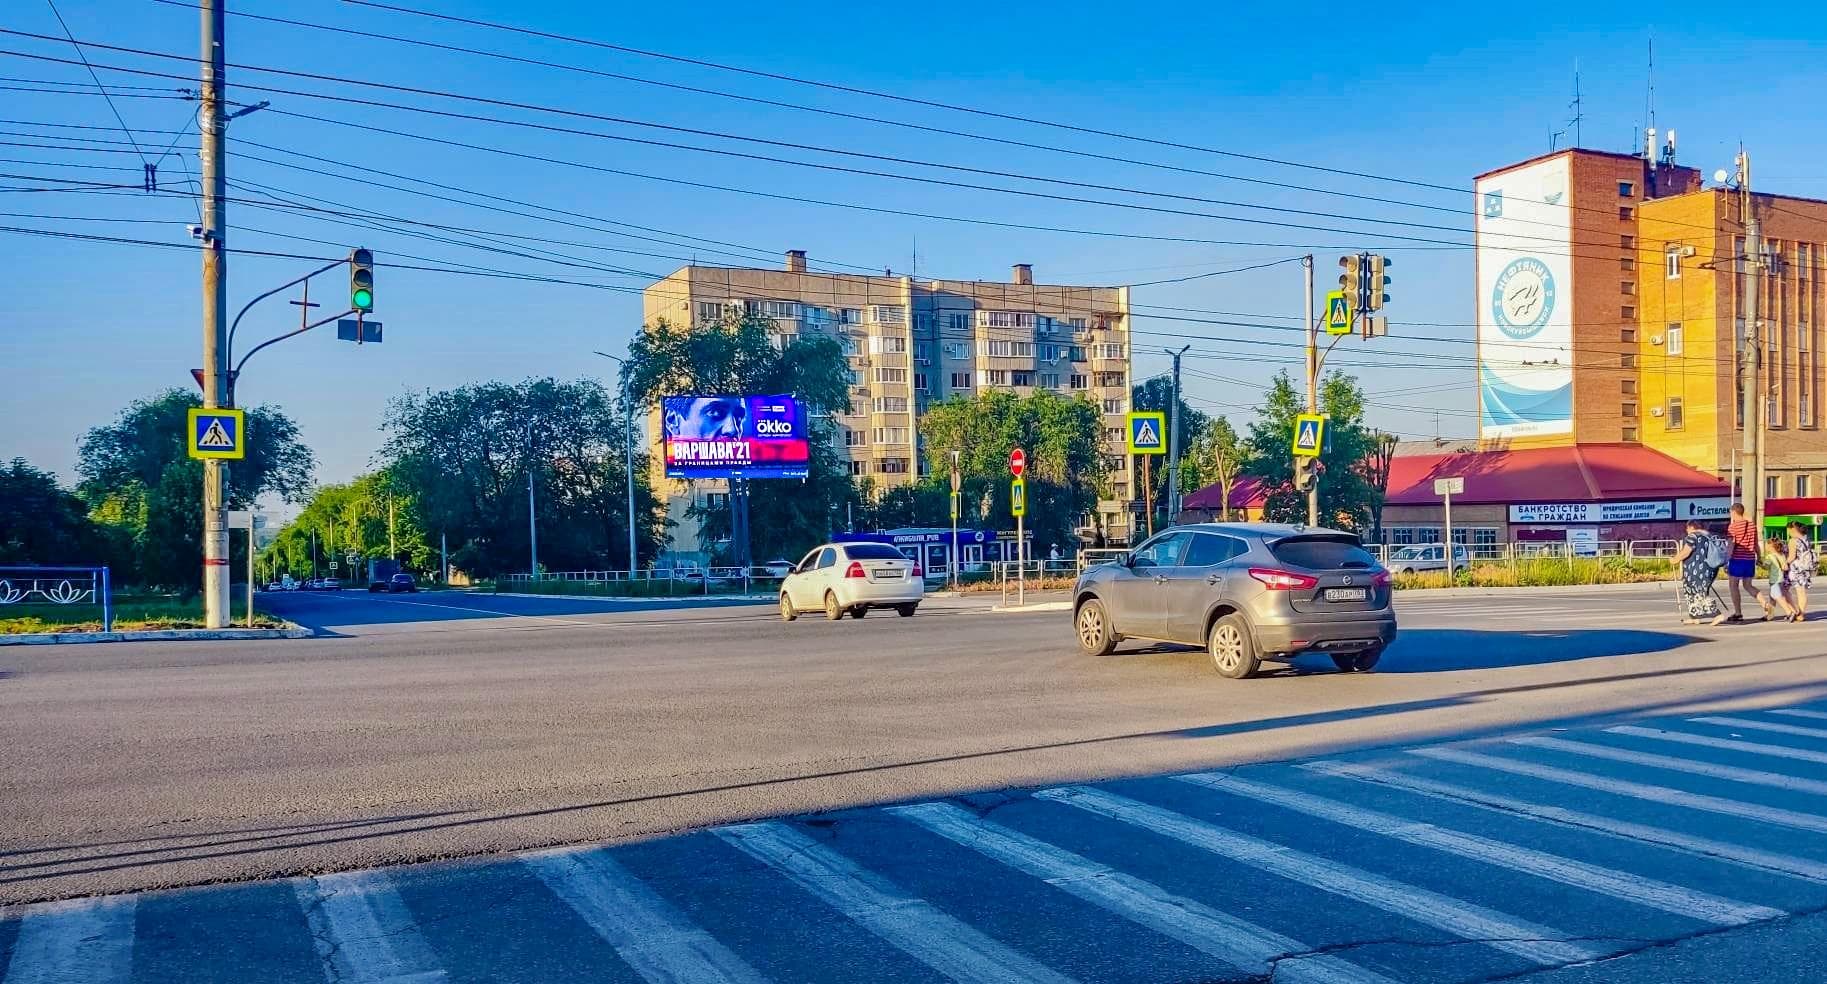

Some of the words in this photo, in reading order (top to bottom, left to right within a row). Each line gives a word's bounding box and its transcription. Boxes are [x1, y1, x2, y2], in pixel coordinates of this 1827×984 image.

[1497, 260, 1550, 291] НЕФТЯНИК
[1518, 504, 1587, 513] БАНКРОТСТВО
[1697, 505, 1731, 516] Ростелек
[1538, 513, 1587, 521] ГРАЖДАН
